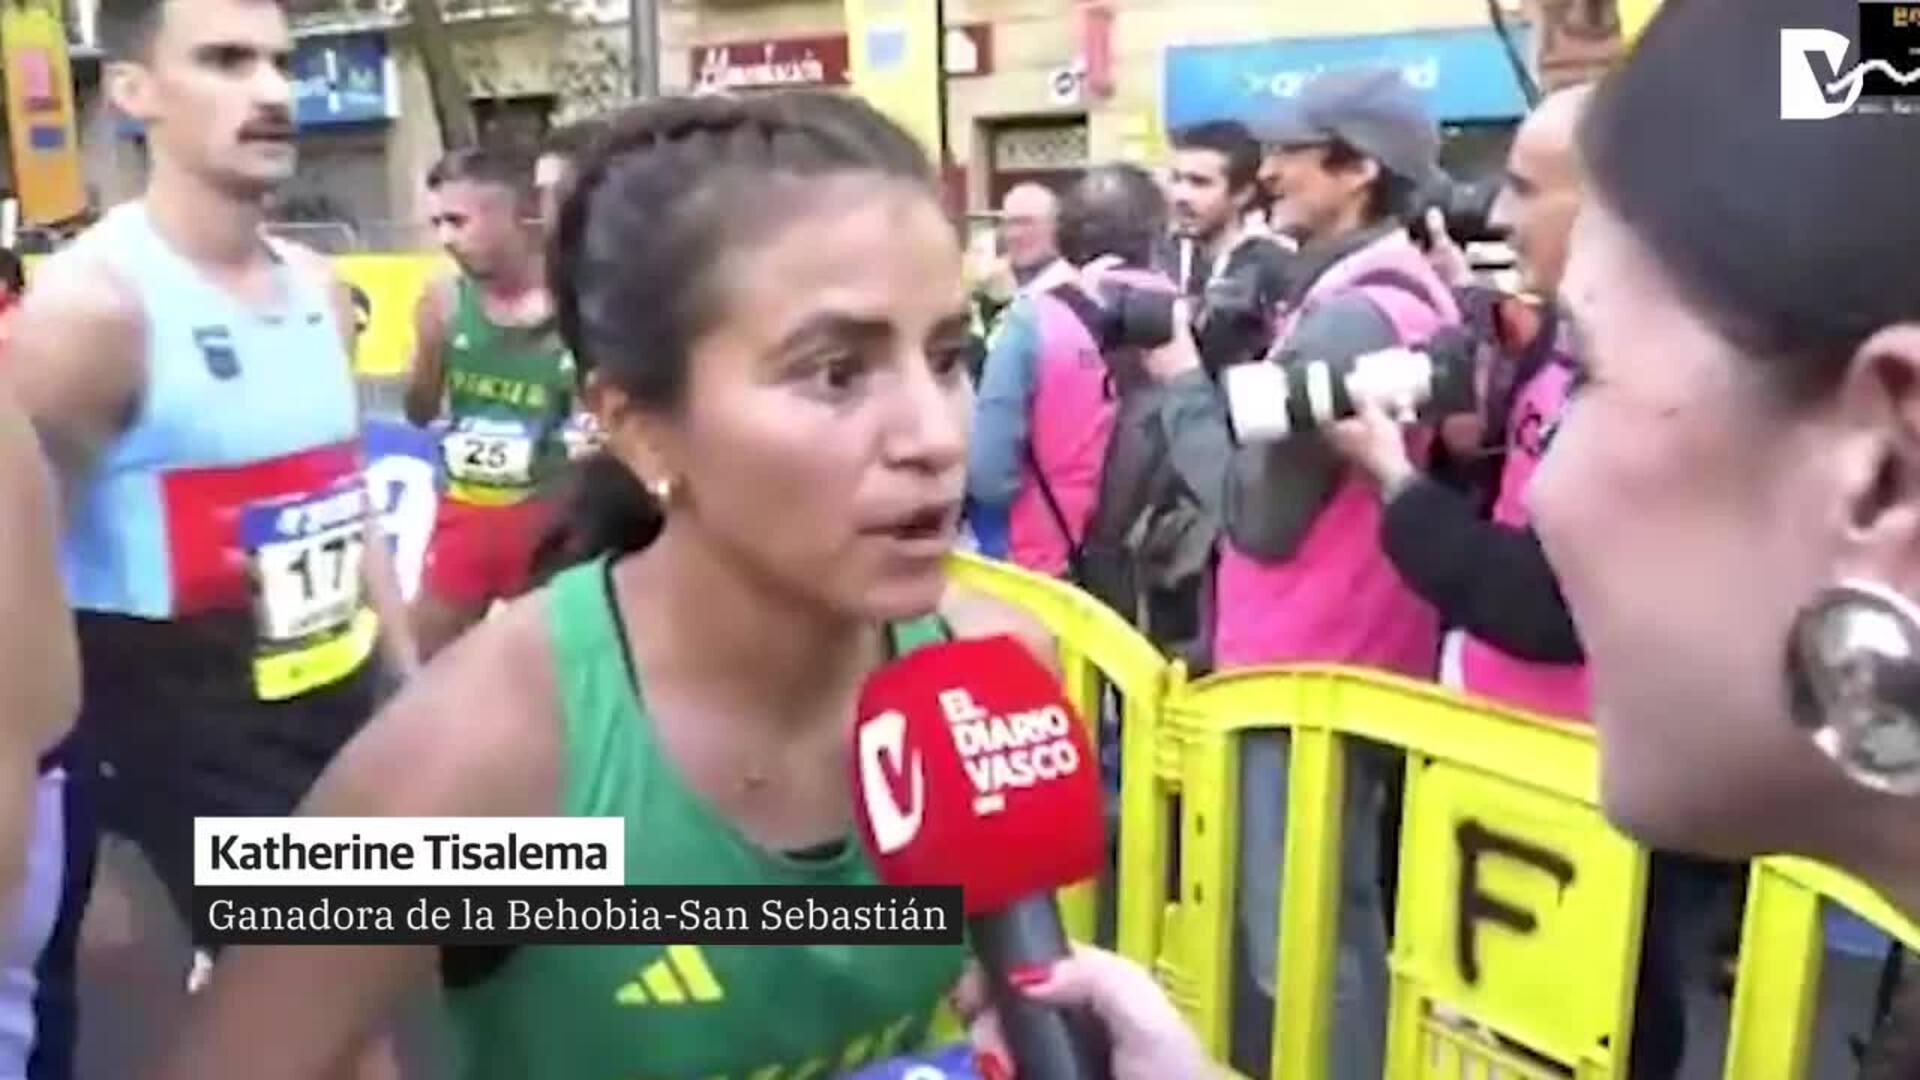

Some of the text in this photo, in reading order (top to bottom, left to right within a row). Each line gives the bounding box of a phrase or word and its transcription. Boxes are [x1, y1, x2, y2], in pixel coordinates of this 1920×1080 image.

[465, 439, 506, 468] 25
[288, 532, 364, 600] 17
[938, 688, 987, 721] EL
[952, 705, 1068, 757] DIARIO
[963, 738, 1080, 794] VASCO
[1456, 818, 1576, 986] F
